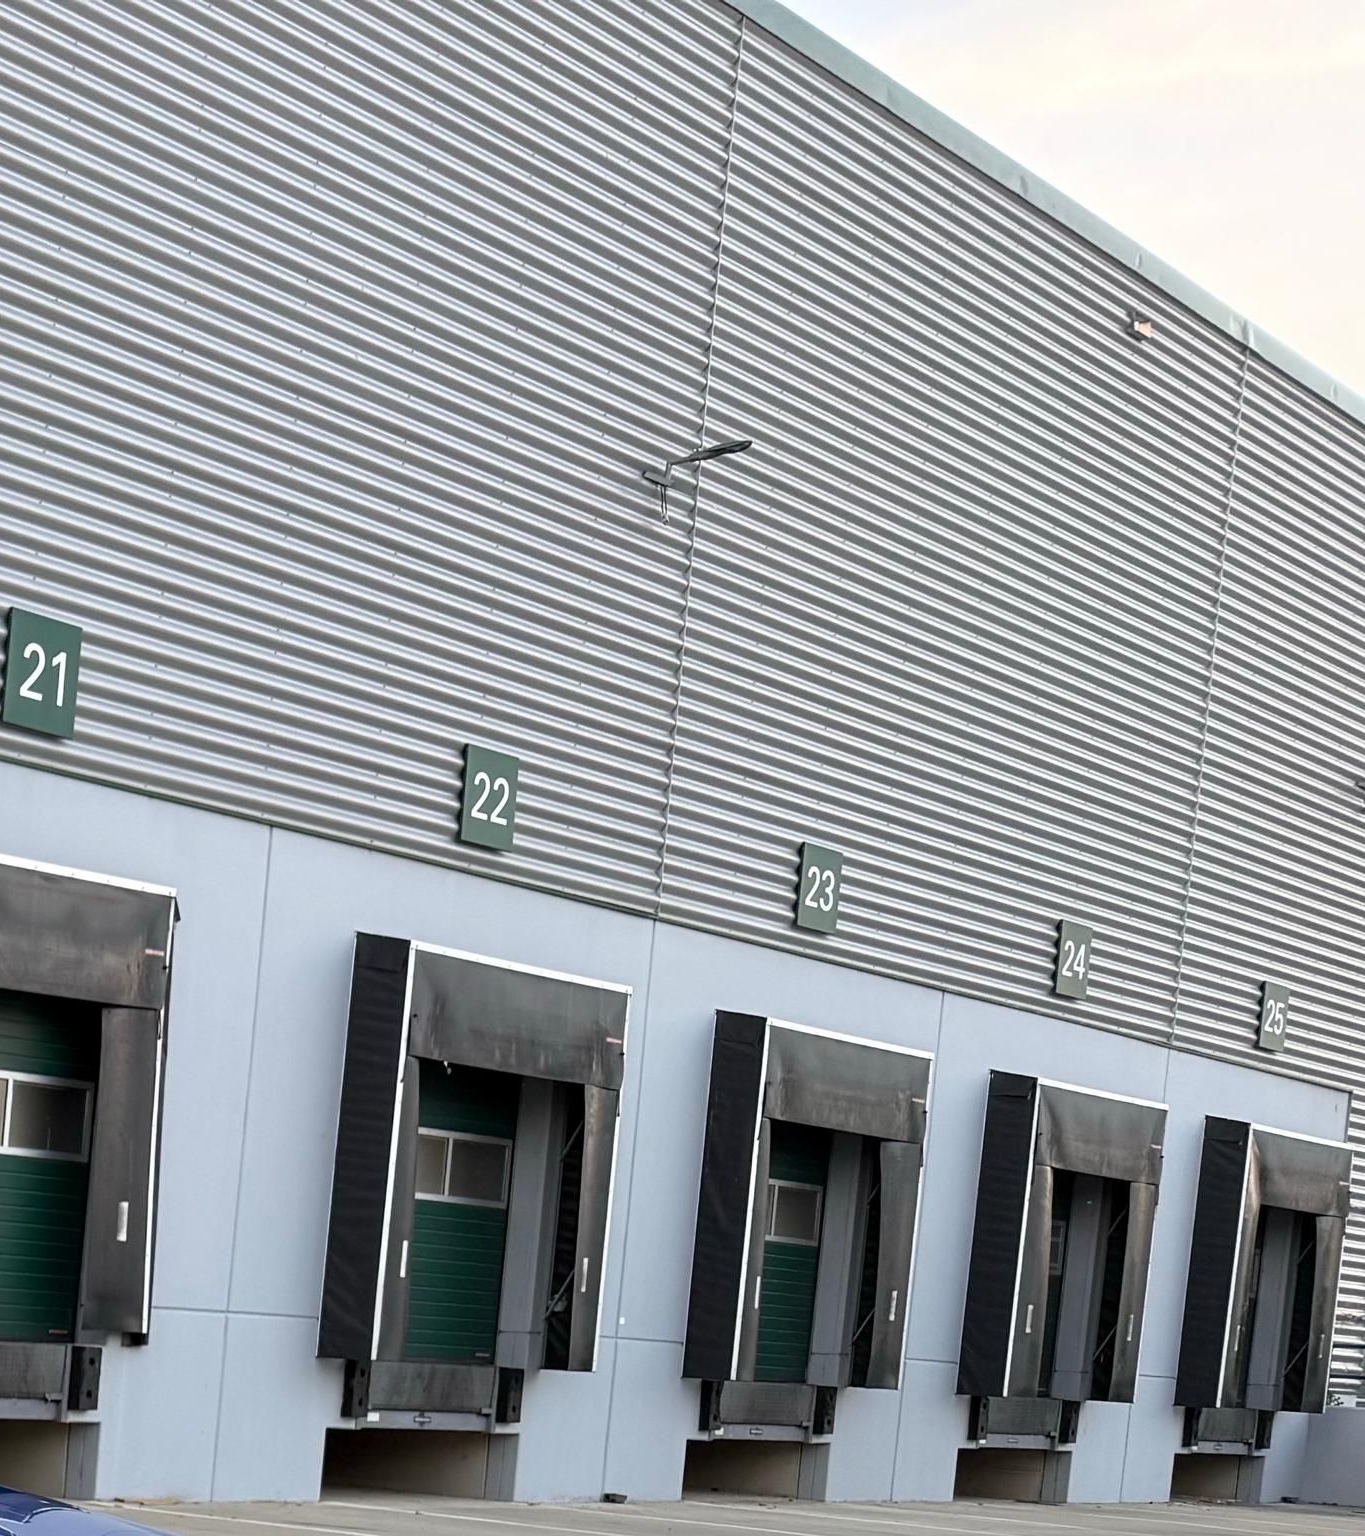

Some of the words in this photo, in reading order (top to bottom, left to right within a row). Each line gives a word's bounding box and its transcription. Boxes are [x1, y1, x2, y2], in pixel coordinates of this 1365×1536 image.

[19, 642, 67, 707] 21
[470, 771, 510, 826] 22
[804, 865, 836, 912] 23
[1061, 940, 1086, 980] 24
[1264, 999, 1286, 1035] 25
